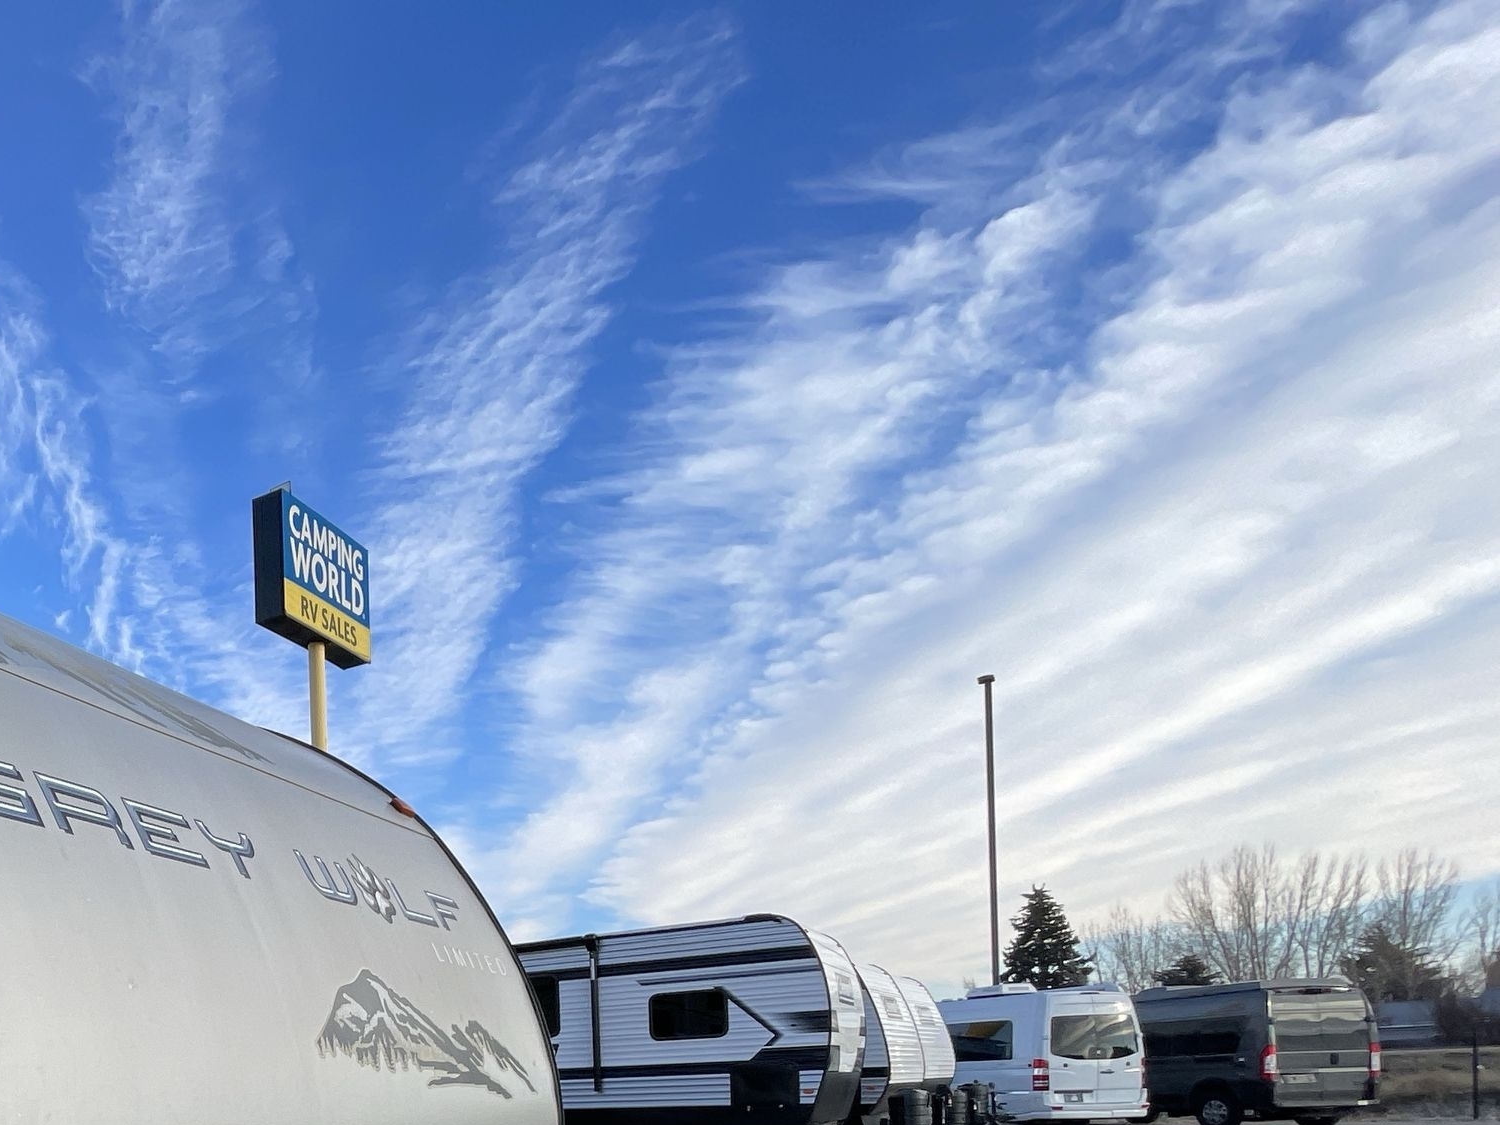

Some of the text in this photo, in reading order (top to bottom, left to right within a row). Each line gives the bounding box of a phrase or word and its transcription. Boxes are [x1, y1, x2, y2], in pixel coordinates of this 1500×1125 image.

[288, 504, 364, 581] CAMPING
[289, 536, 365, 616] WORLD
[300, 595, 358, 647] RV SALES
[431, 943, 507, 976] LIMITED
